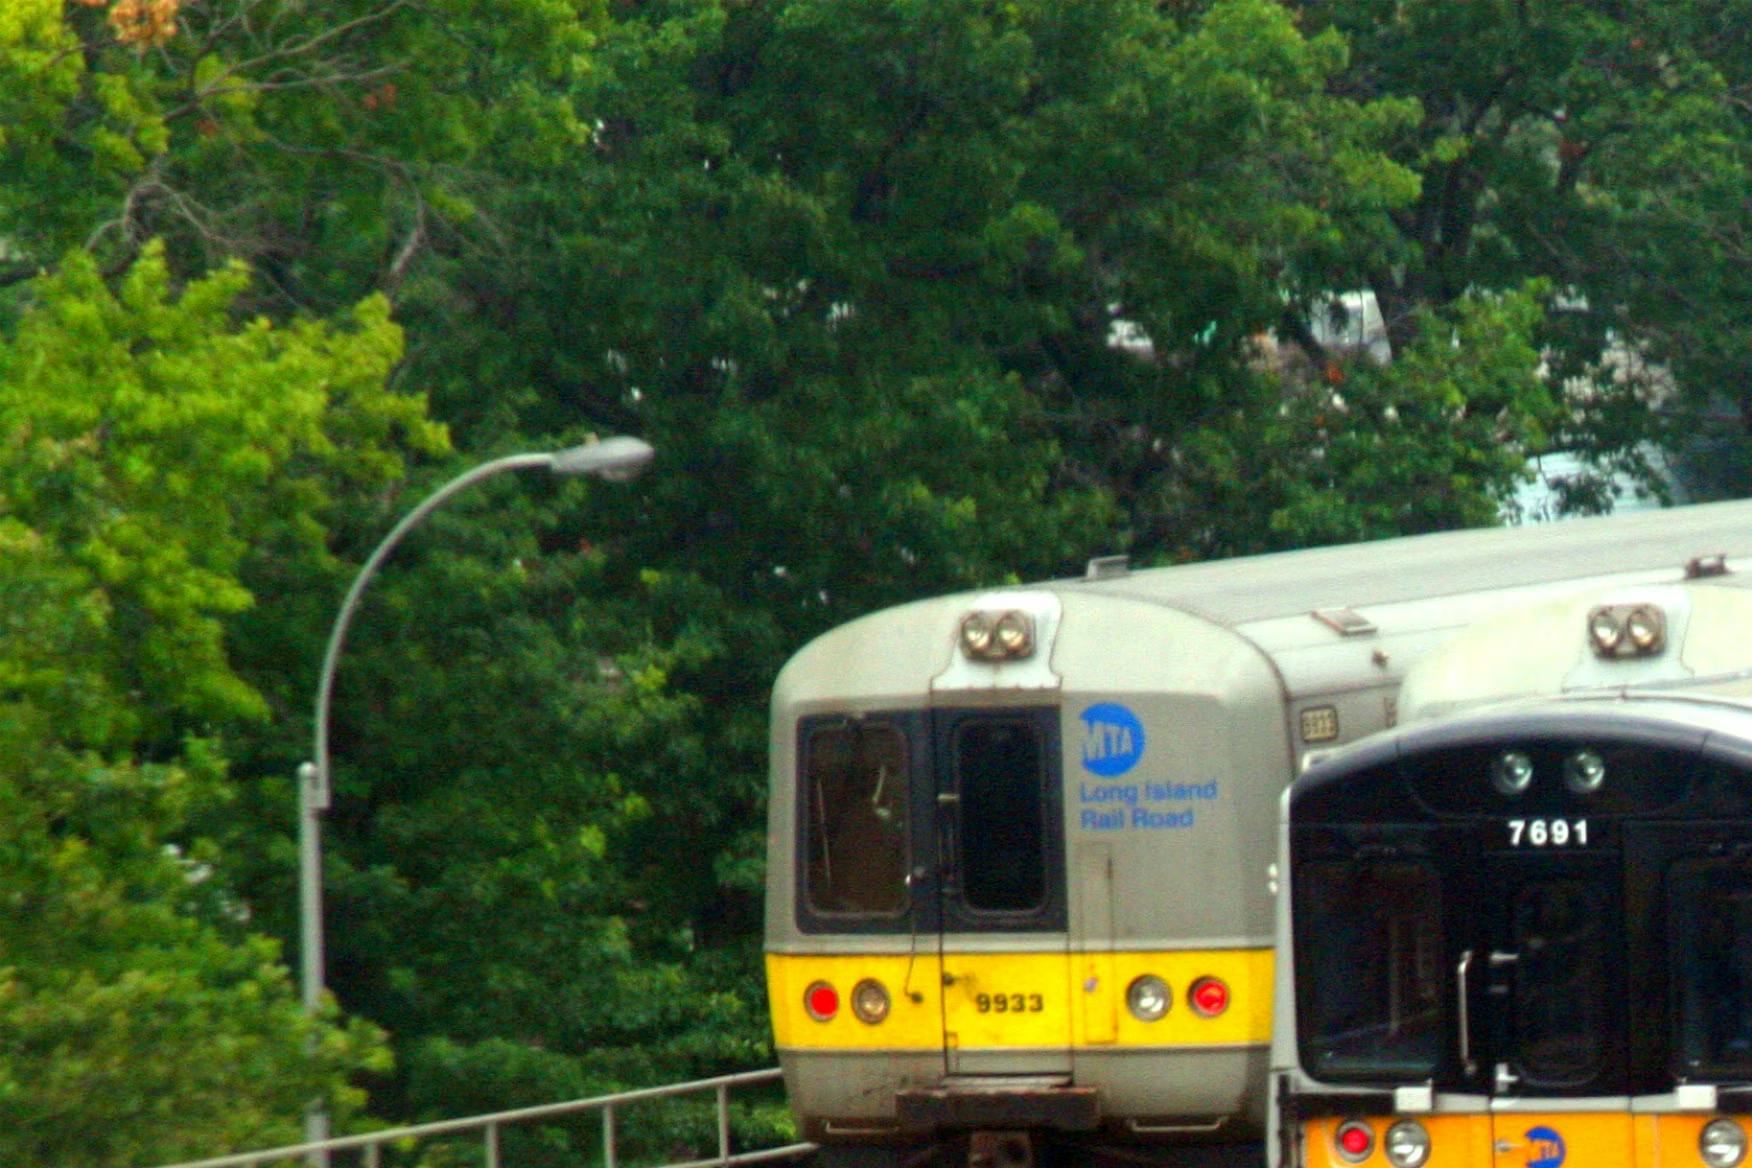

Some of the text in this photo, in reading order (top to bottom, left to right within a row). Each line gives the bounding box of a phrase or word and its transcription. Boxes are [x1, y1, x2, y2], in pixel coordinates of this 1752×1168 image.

[1081, 717, 1140, 763] MTA
[1080, 780, 1217, 806] Long Island
[1080, 808, 1194, 829] Rail Road
[1507, 819, 1588, 846] 7691
[976, 993, 1043, 1014] 9933
